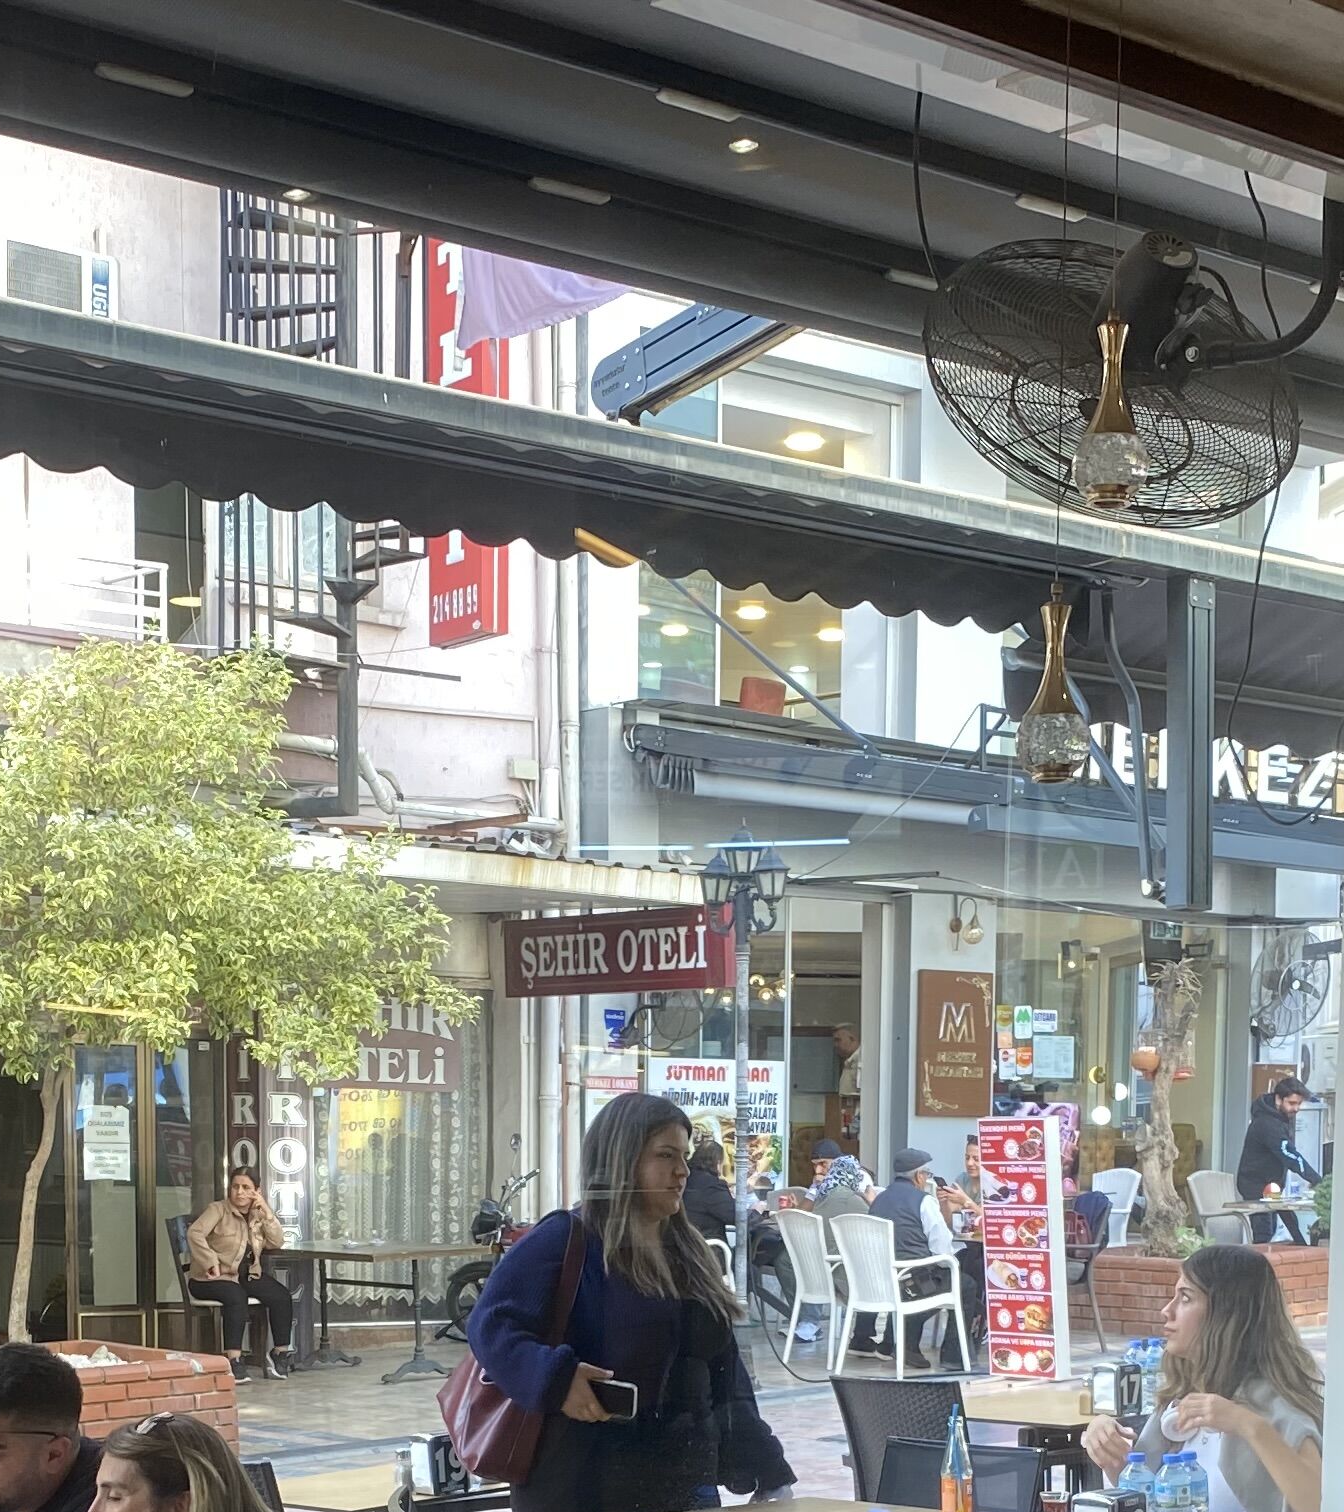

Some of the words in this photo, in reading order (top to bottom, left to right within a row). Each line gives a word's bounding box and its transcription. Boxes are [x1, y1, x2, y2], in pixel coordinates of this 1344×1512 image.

[520, 922, 609, 989] ŞEHİR
[617, 913, 708, 974] OTELİ
[666, 1064, 726, 1081] SÜTMAN
[759, 1089, 778, 1106] PİDE
[1120, 1374, 1140, 1406] 17
